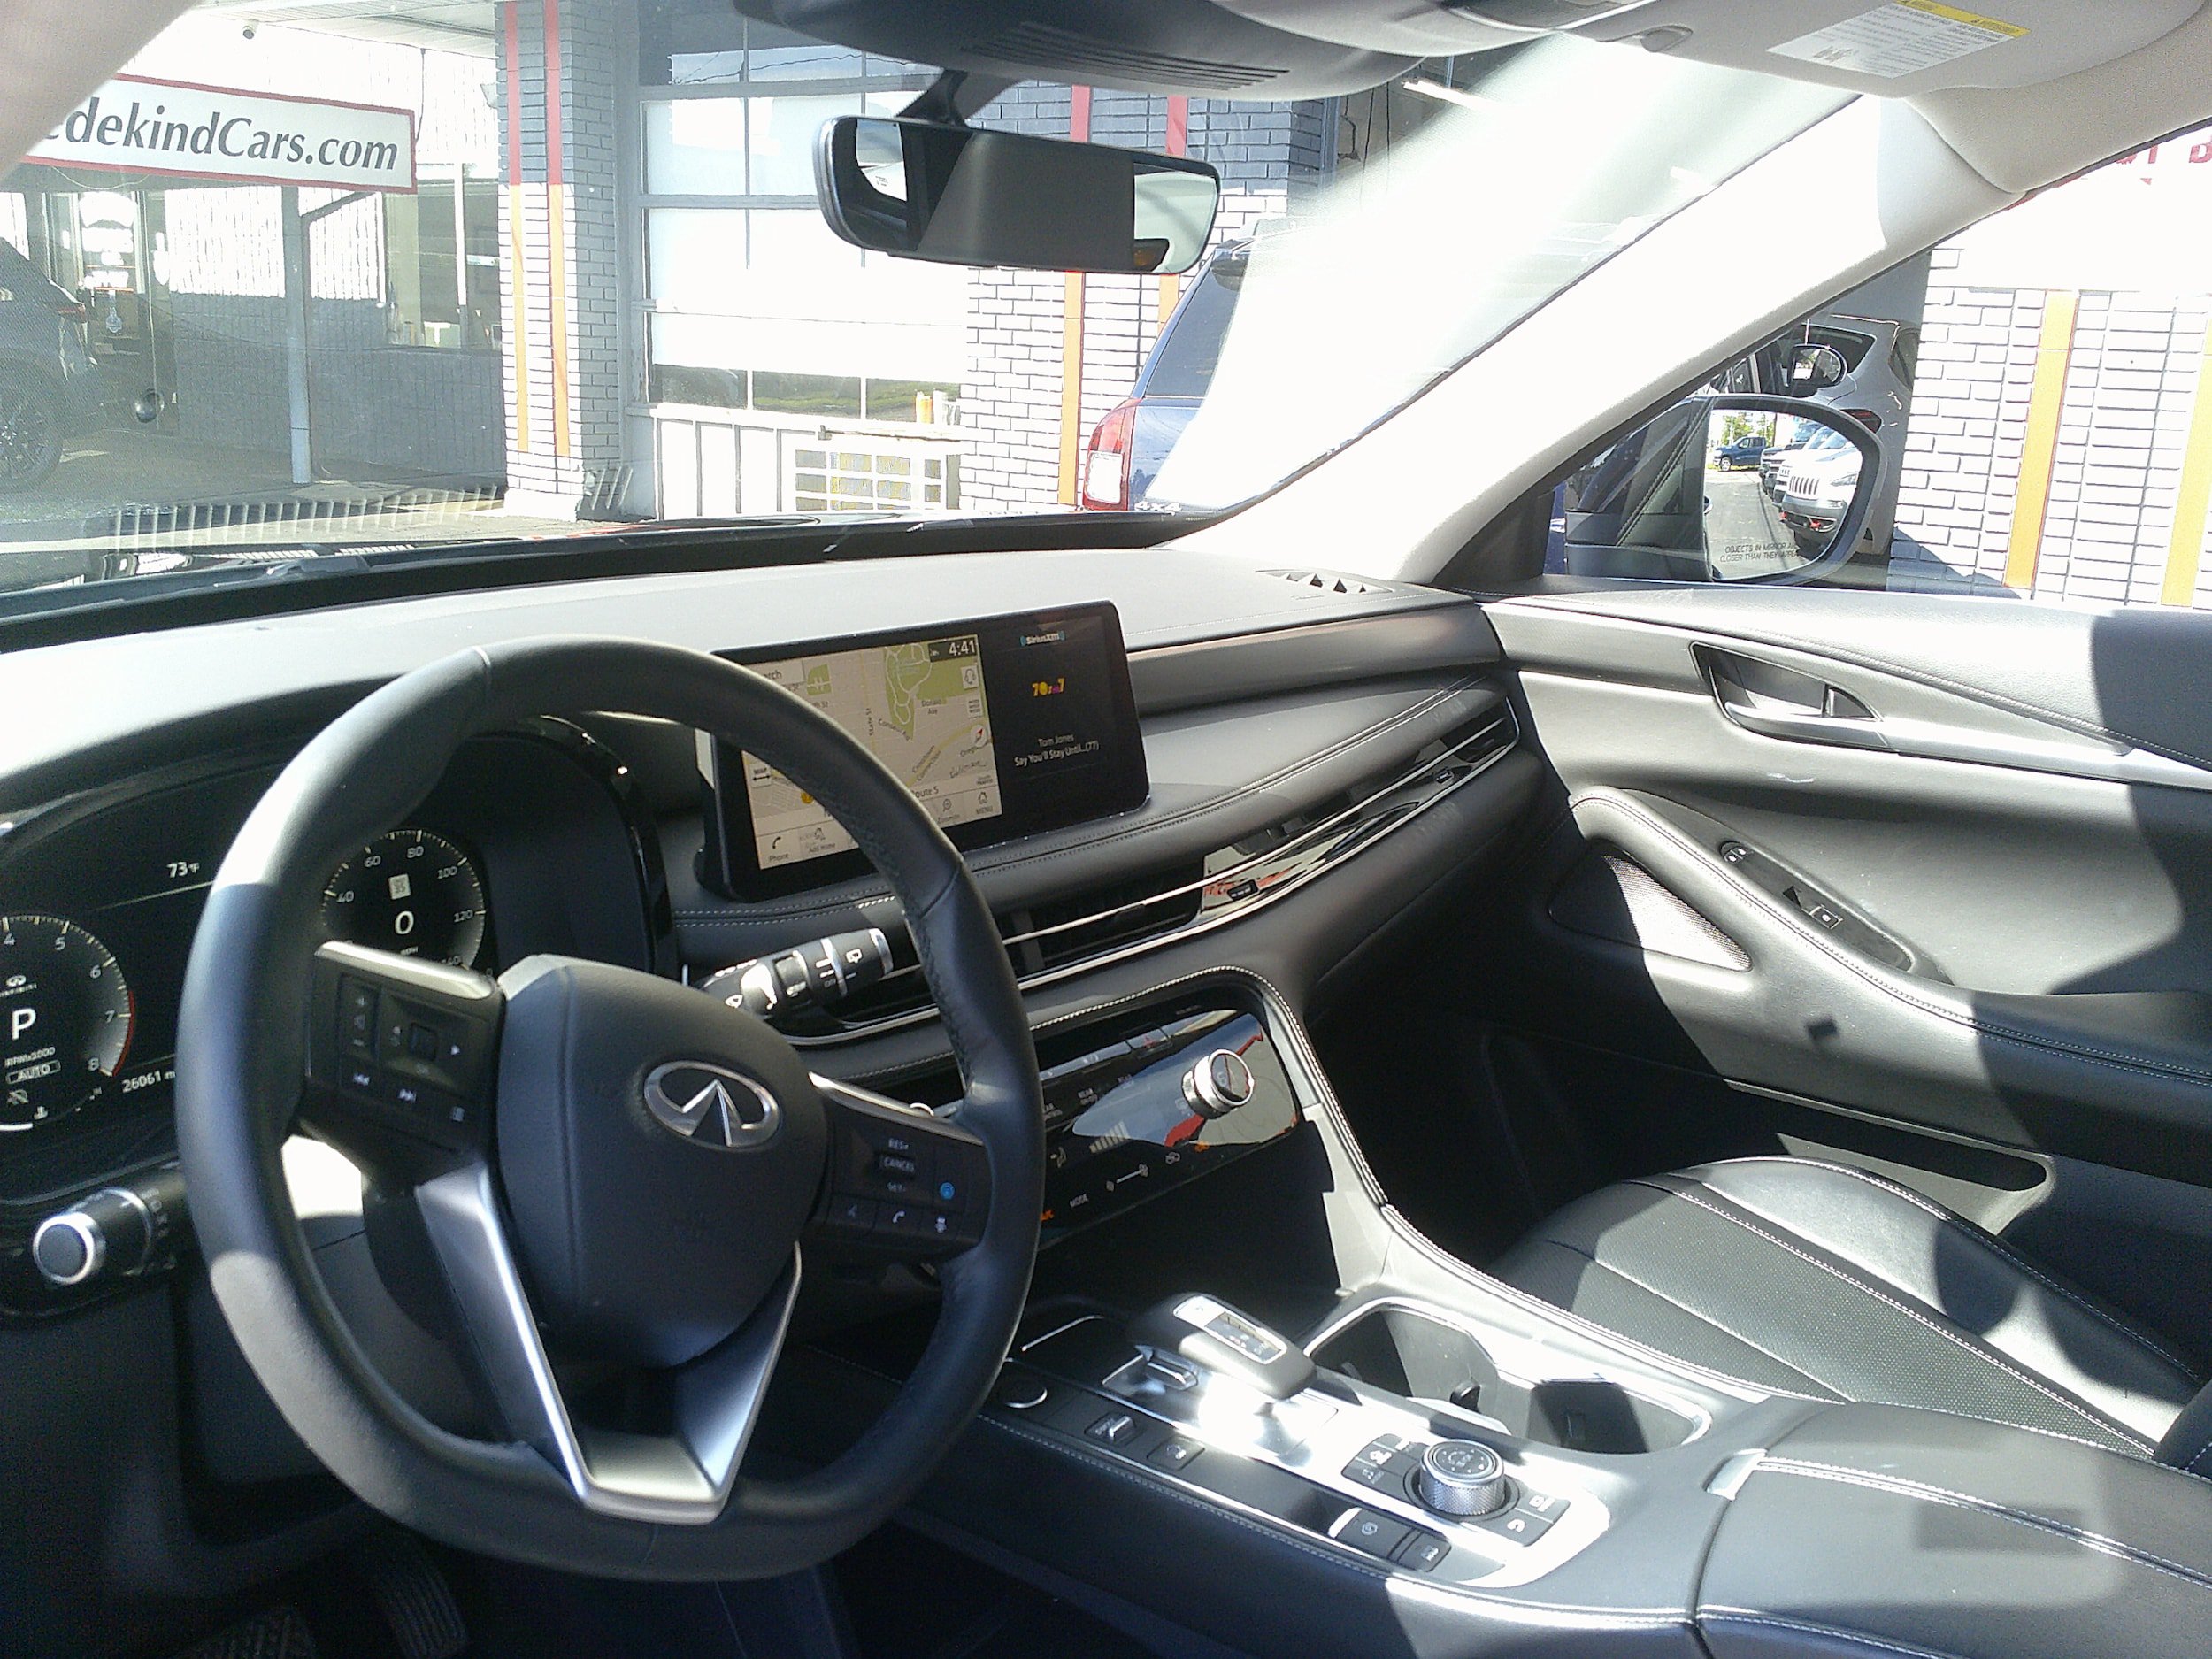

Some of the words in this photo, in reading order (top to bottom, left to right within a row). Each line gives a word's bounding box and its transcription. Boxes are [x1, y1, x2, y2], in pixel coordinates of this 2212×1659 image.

[1134, 501, 1183, 512] 4x4
[949, 640, 975, 656] 4:41
[1038, 737, 1055, 748] Tom
[1055, 733, 1075, 745] Jones
[1014, 756, 1028, 767] Say
[1029, 750, 1049, 764] You'll
[1049, 748, 1065, 761] Stay
[407, 845, 425, 859] 80
[364, 855, 381, 868] 60
[437, 866, 457, 879] 100
[336, 890, 355, 903] 40
[395, 910, 415, 935] 0
[453, 910, 474, 923] 120
[4, 933, 15, 945] 4
[55, 936, 66, 950] 5
[89, 964, 101, 979] 6
[12, 1007, 37, 1041] P
[105, 1010, 115, 1024] 7
[88, 1057, 100, 1071] 8
[17, 1064, 51, 1079] AUTO
[122, 1070, 161, 1093] 26061
